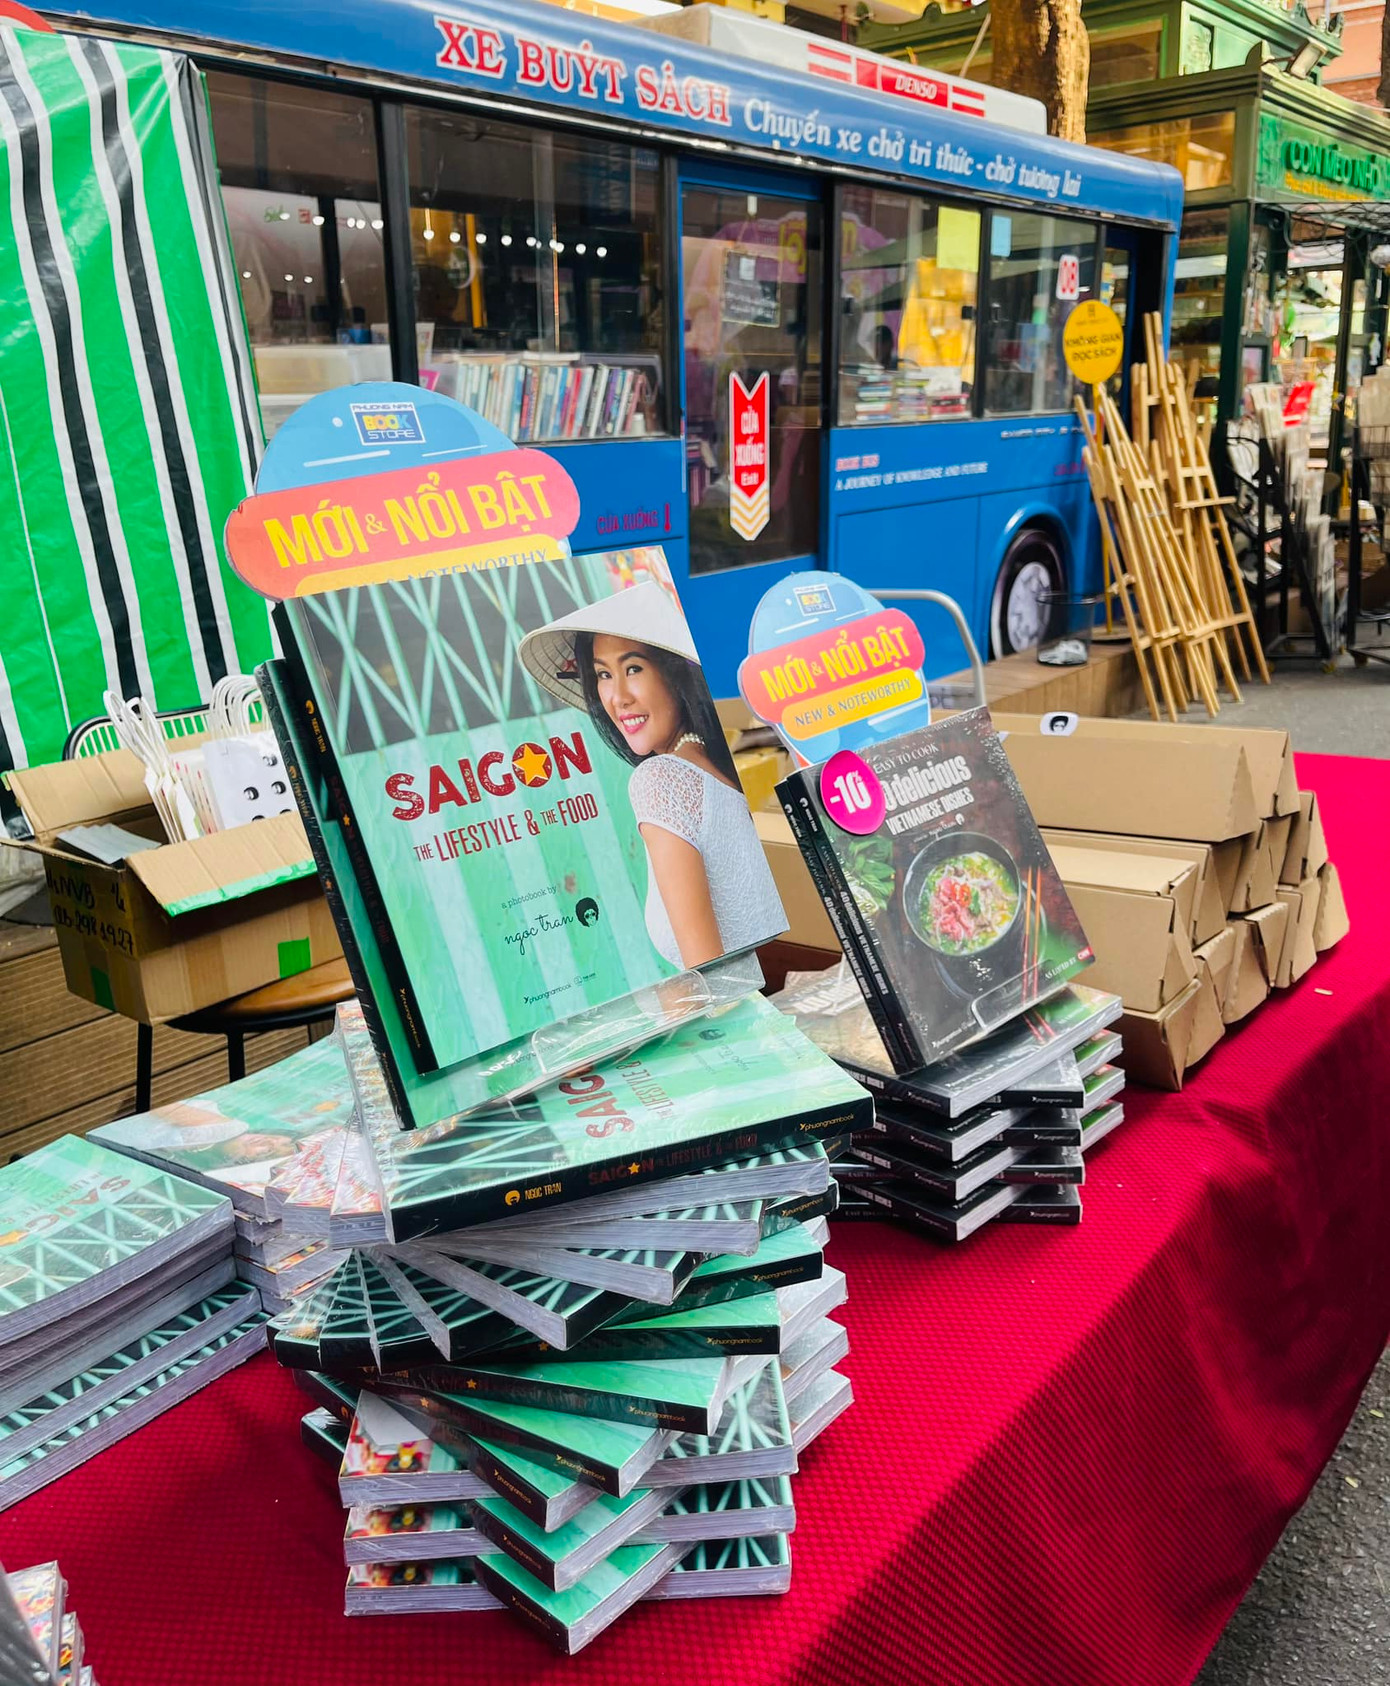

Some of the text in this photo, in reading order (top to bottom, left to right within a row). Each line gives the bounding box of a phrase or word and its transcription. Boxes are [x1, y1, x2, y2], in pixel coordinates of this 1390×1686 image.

[435, 16, 506, 77] XE
[744, 98, 831, 147] Chuyến
[836, 127, 862, 153] xe
[868, 127, 905, 161] chở
[909, 138, 931, 168] tri
[1062, 169, 1081, 197] lai
[895, 74, 937, 100] DENSO
[362, 414, 413, 431] BOOK
[262, 471, 554, 568] MỚI & NỔI BẬT
[759, 625, 910, 702] MỚI & NỔI BẬT
[795, 677, 912, 727] NEW & NOTEWORTHY
[384, 731, 593, 821] SAIGON
[873, 743, 939, 774] EASY TO COOK
[891, 755, 972, 807] delicious
[413, 793, 599, 862] THE LIFESTYLE & THE FOOD
[886, 786, 975, 835] VIETNAMESE DISHES
[508, 889, 547, 909] photobook
[505, 914, 574, 955] ngoc tran
[621, 1069, 675, 1112] LIFESTYLE
[805, 1113, 855, 1133] phuongnambook
[525, 1182, 562, 1200] NGOC TRAN
